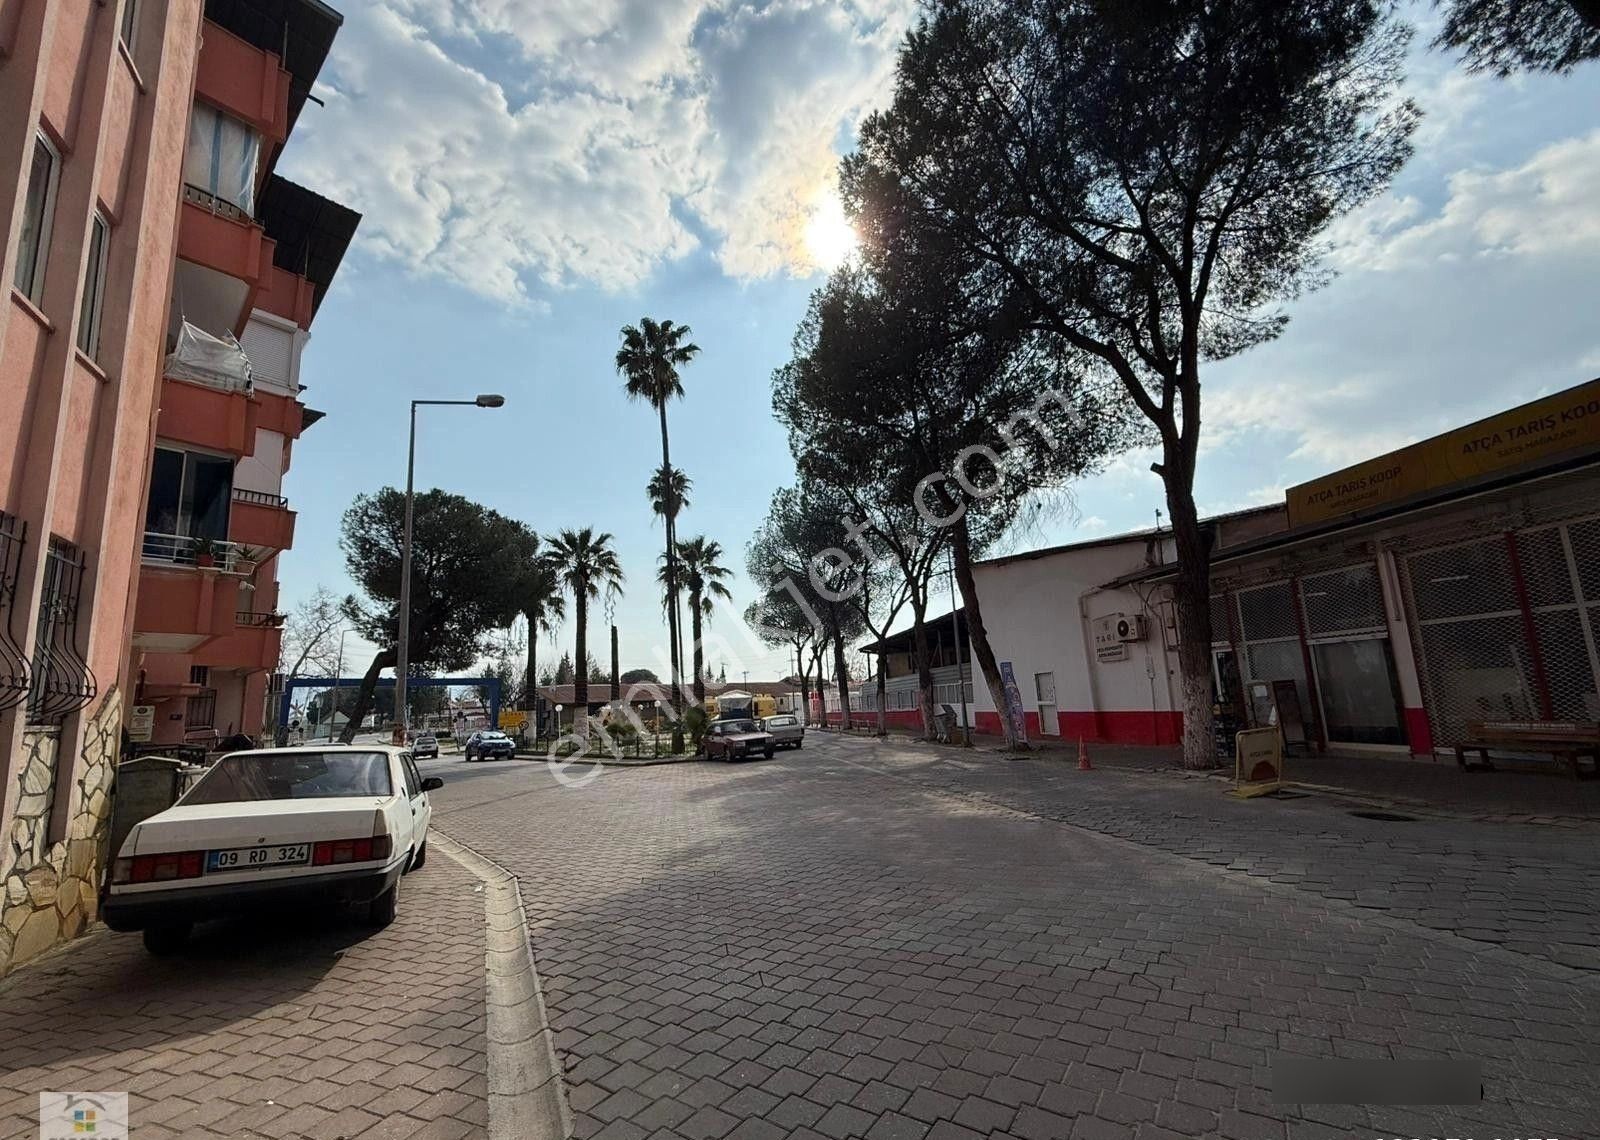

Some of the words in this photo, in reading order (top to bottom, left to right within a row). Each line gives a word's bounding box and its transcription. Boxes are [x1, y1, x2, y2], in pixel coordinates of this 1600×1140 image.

[1463, 433, 1503, 454] ATÇA
[1307, 489, 1333, 505] ATÇA
[1369, 466, 1402, 485] KOOP
[219, 852, 238, 866] 09
[249, 849, 267, 863] RD
[278, 846, 305, 861] 324
